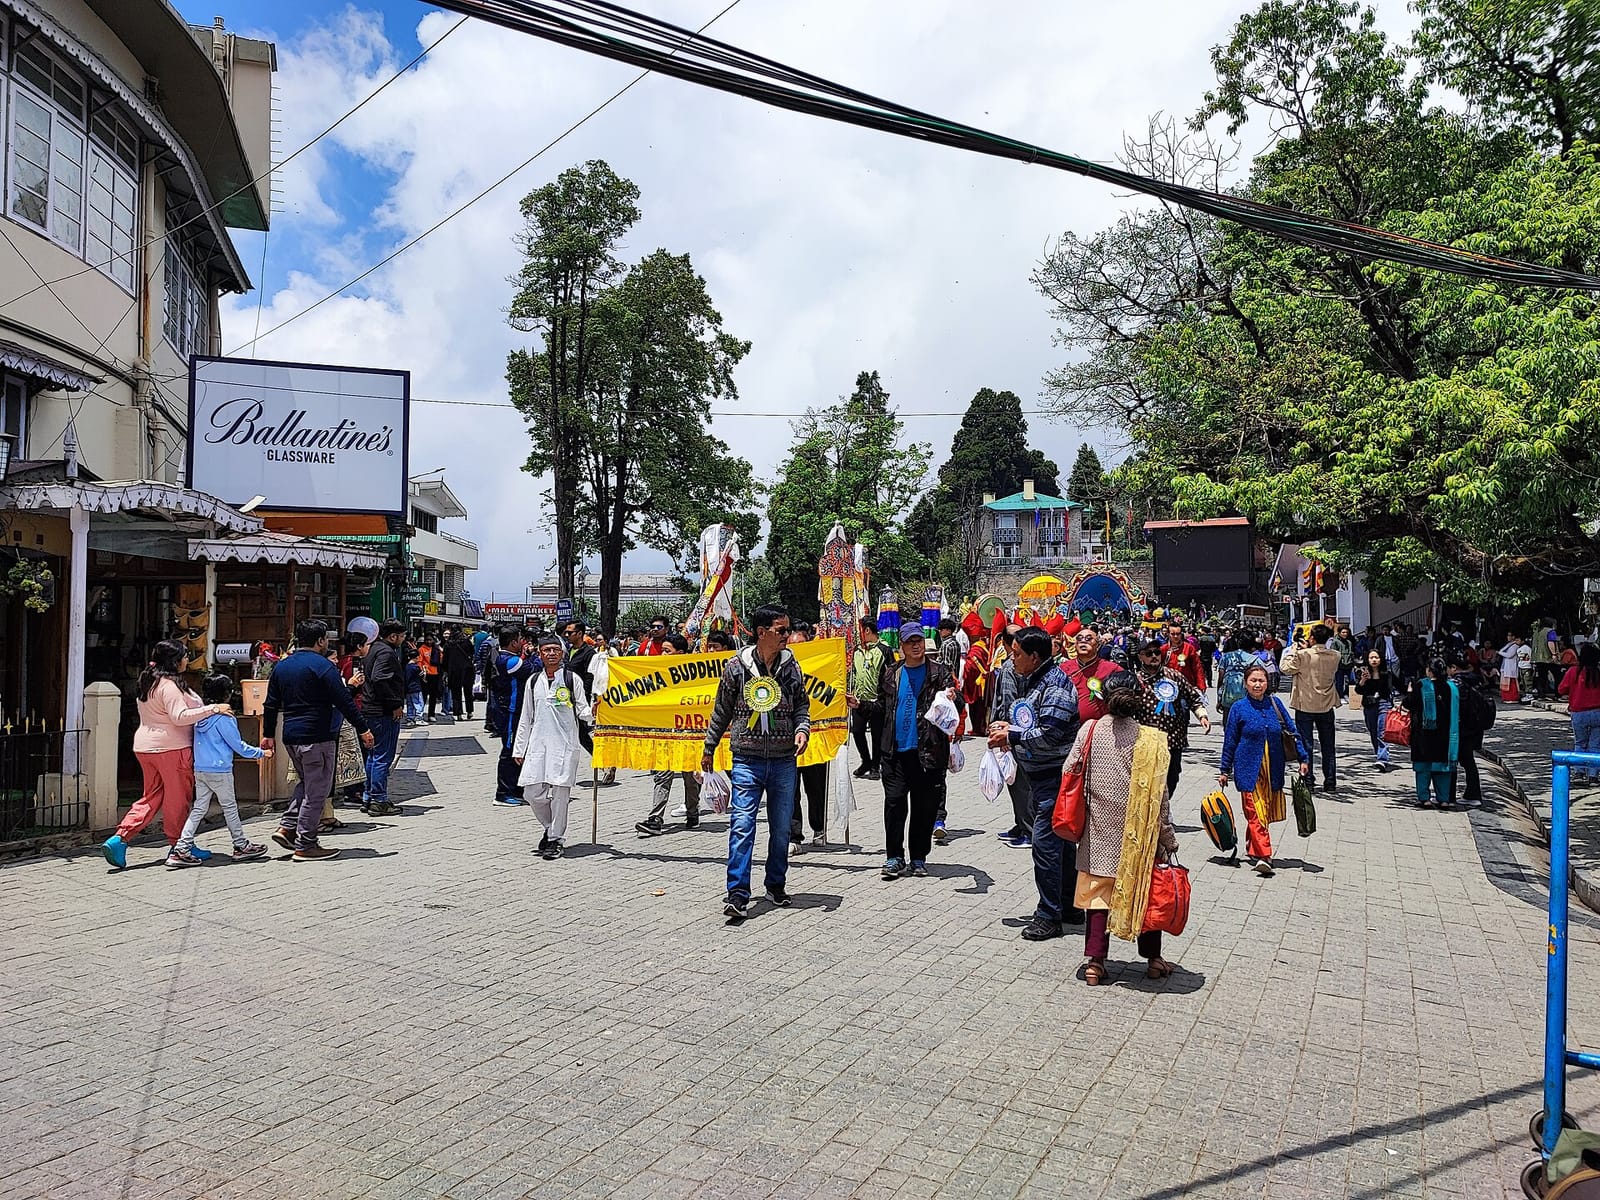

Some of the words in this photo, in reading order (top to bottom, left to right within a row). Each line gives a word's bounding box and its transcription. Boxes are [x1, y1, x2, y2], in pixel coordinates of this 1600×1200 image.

[204, 397, 393, 452] Ballantine's
[266, 449, 335, 465] GLASSWARE
[602, 671, 668, 708] YOLMOWA
[803, 672, 838, 707] TION
